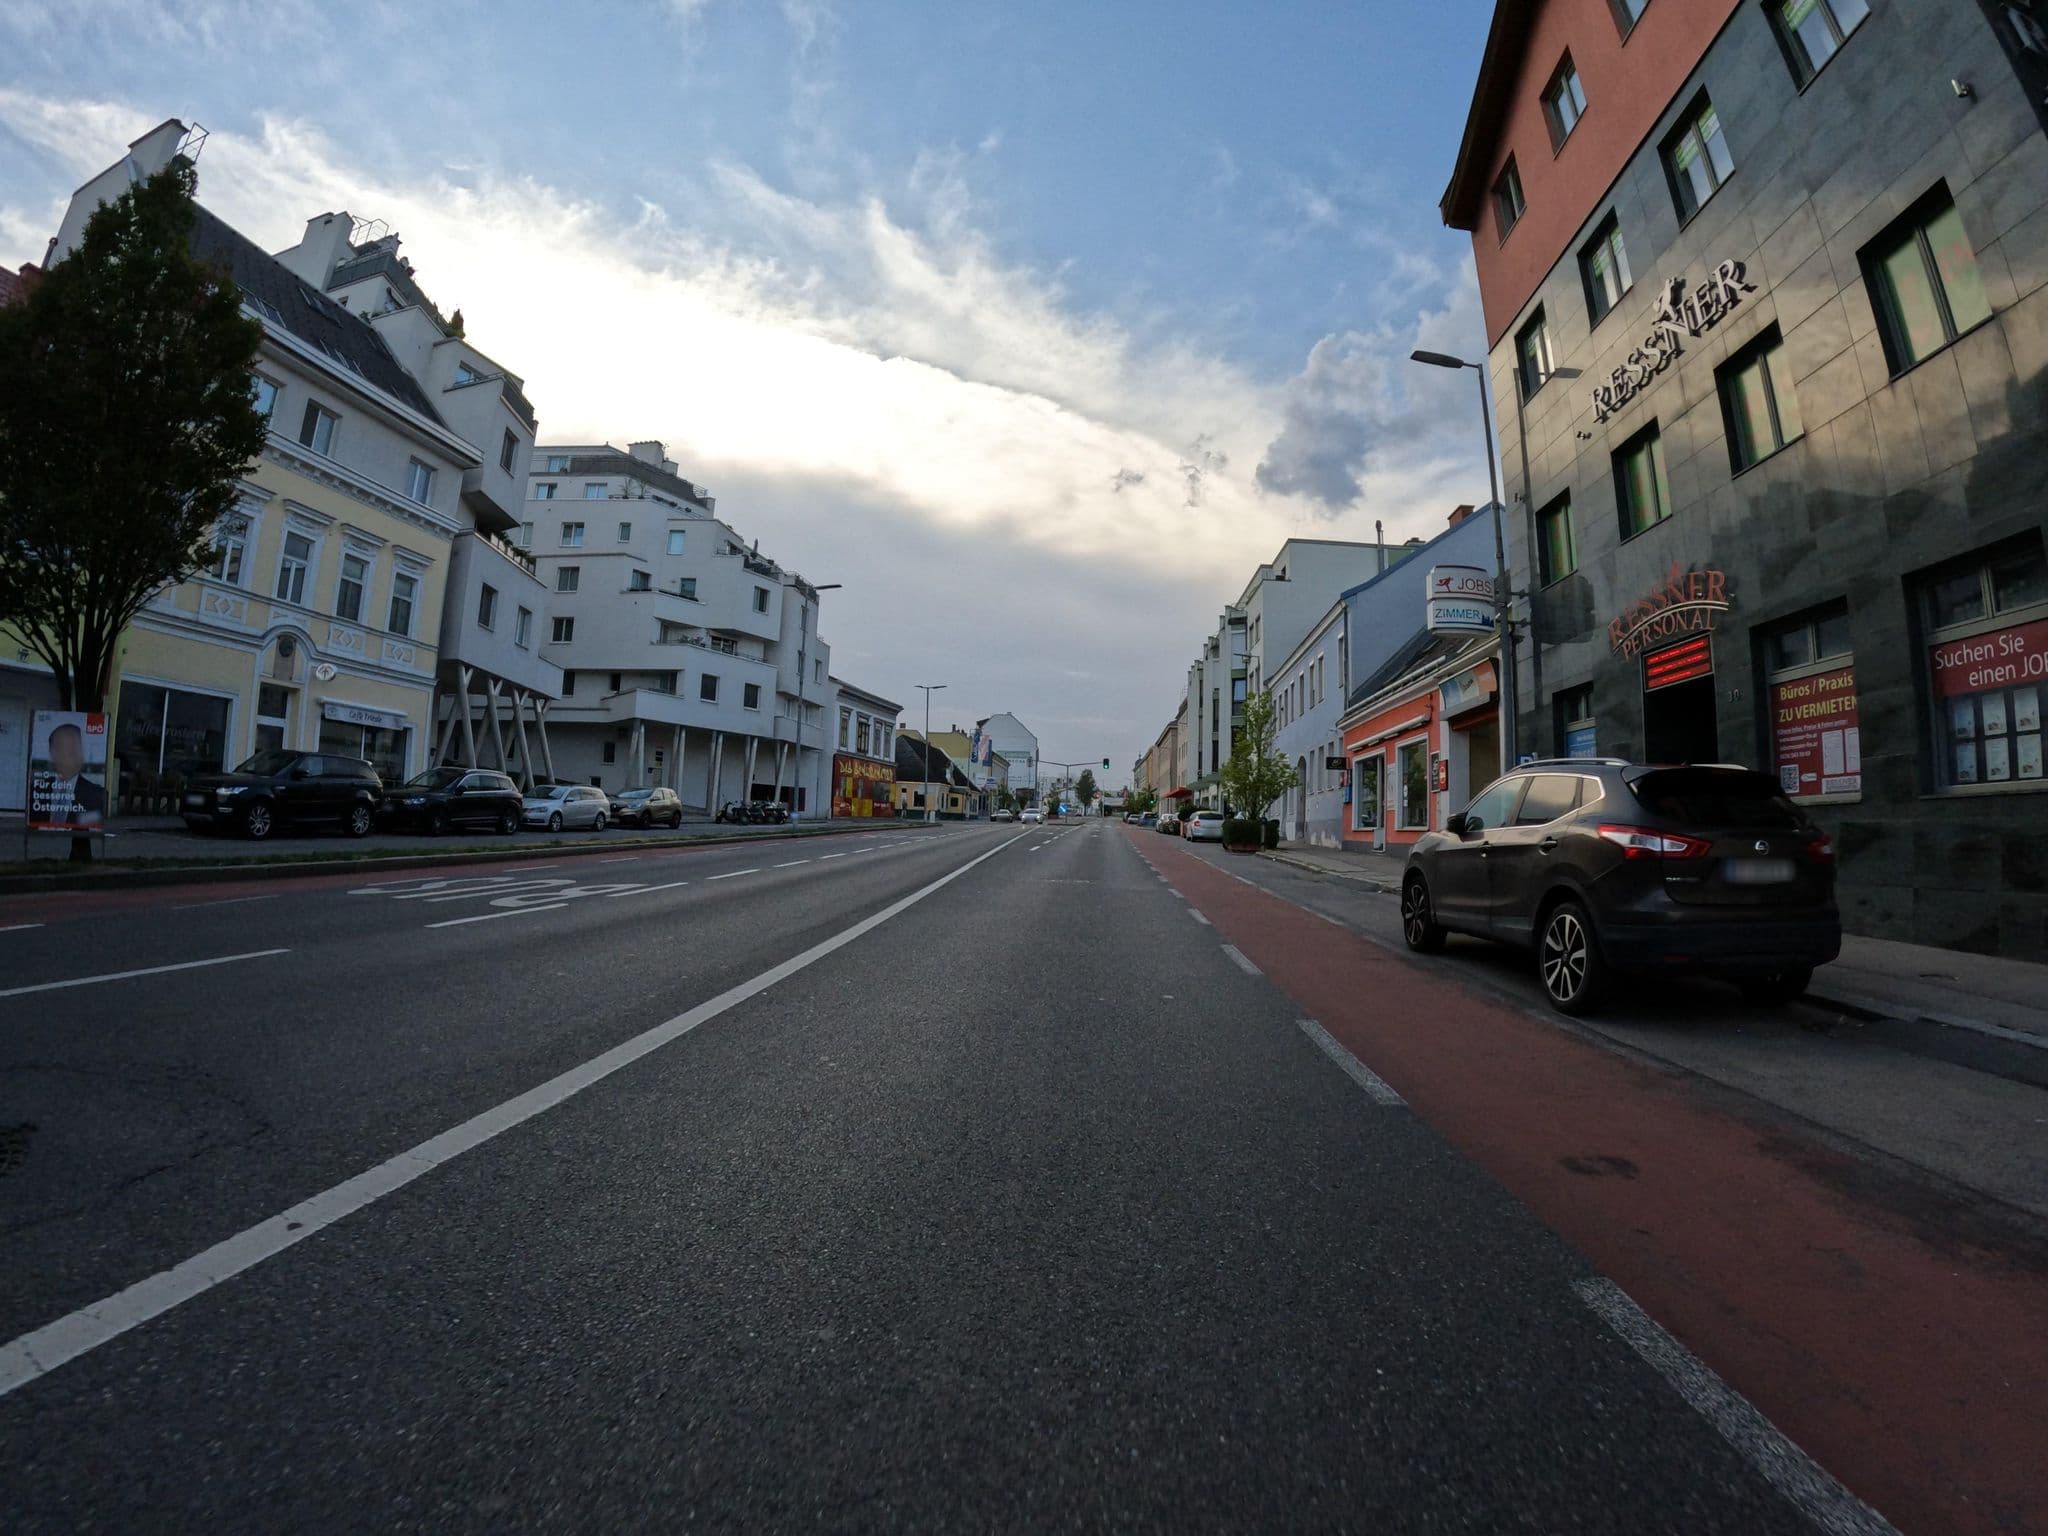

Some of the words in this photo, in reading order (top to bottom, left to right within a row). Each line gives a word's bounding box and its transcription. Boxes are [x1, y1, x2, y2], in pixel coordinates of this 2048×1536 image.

[1592, 258, 1749, 420] RESSNER
[1457, 578, 1492, 594] JOBS
[1435, 608, 1481, 620] ZIMMER
[1621, 608, 1717, 663] PERSONAL
[1935, 643, 1995, 670] Suchen
[1999, 634, 2025, 656] Sie
[1969, 665, 2017, 687] einen
[1780, 684, 1810, 701] Büros
[1819, 672, 1854, 691] Praxis
[1779, 708, 1794, 723] ZU
[87, 724, 103, 733] SPÖ
[33, 779, 49, 789] Für
[51, 780, 72, 790] dein
[33, 791, 75, 801] besseres
[33, 801, 87, 813] Österreich.
